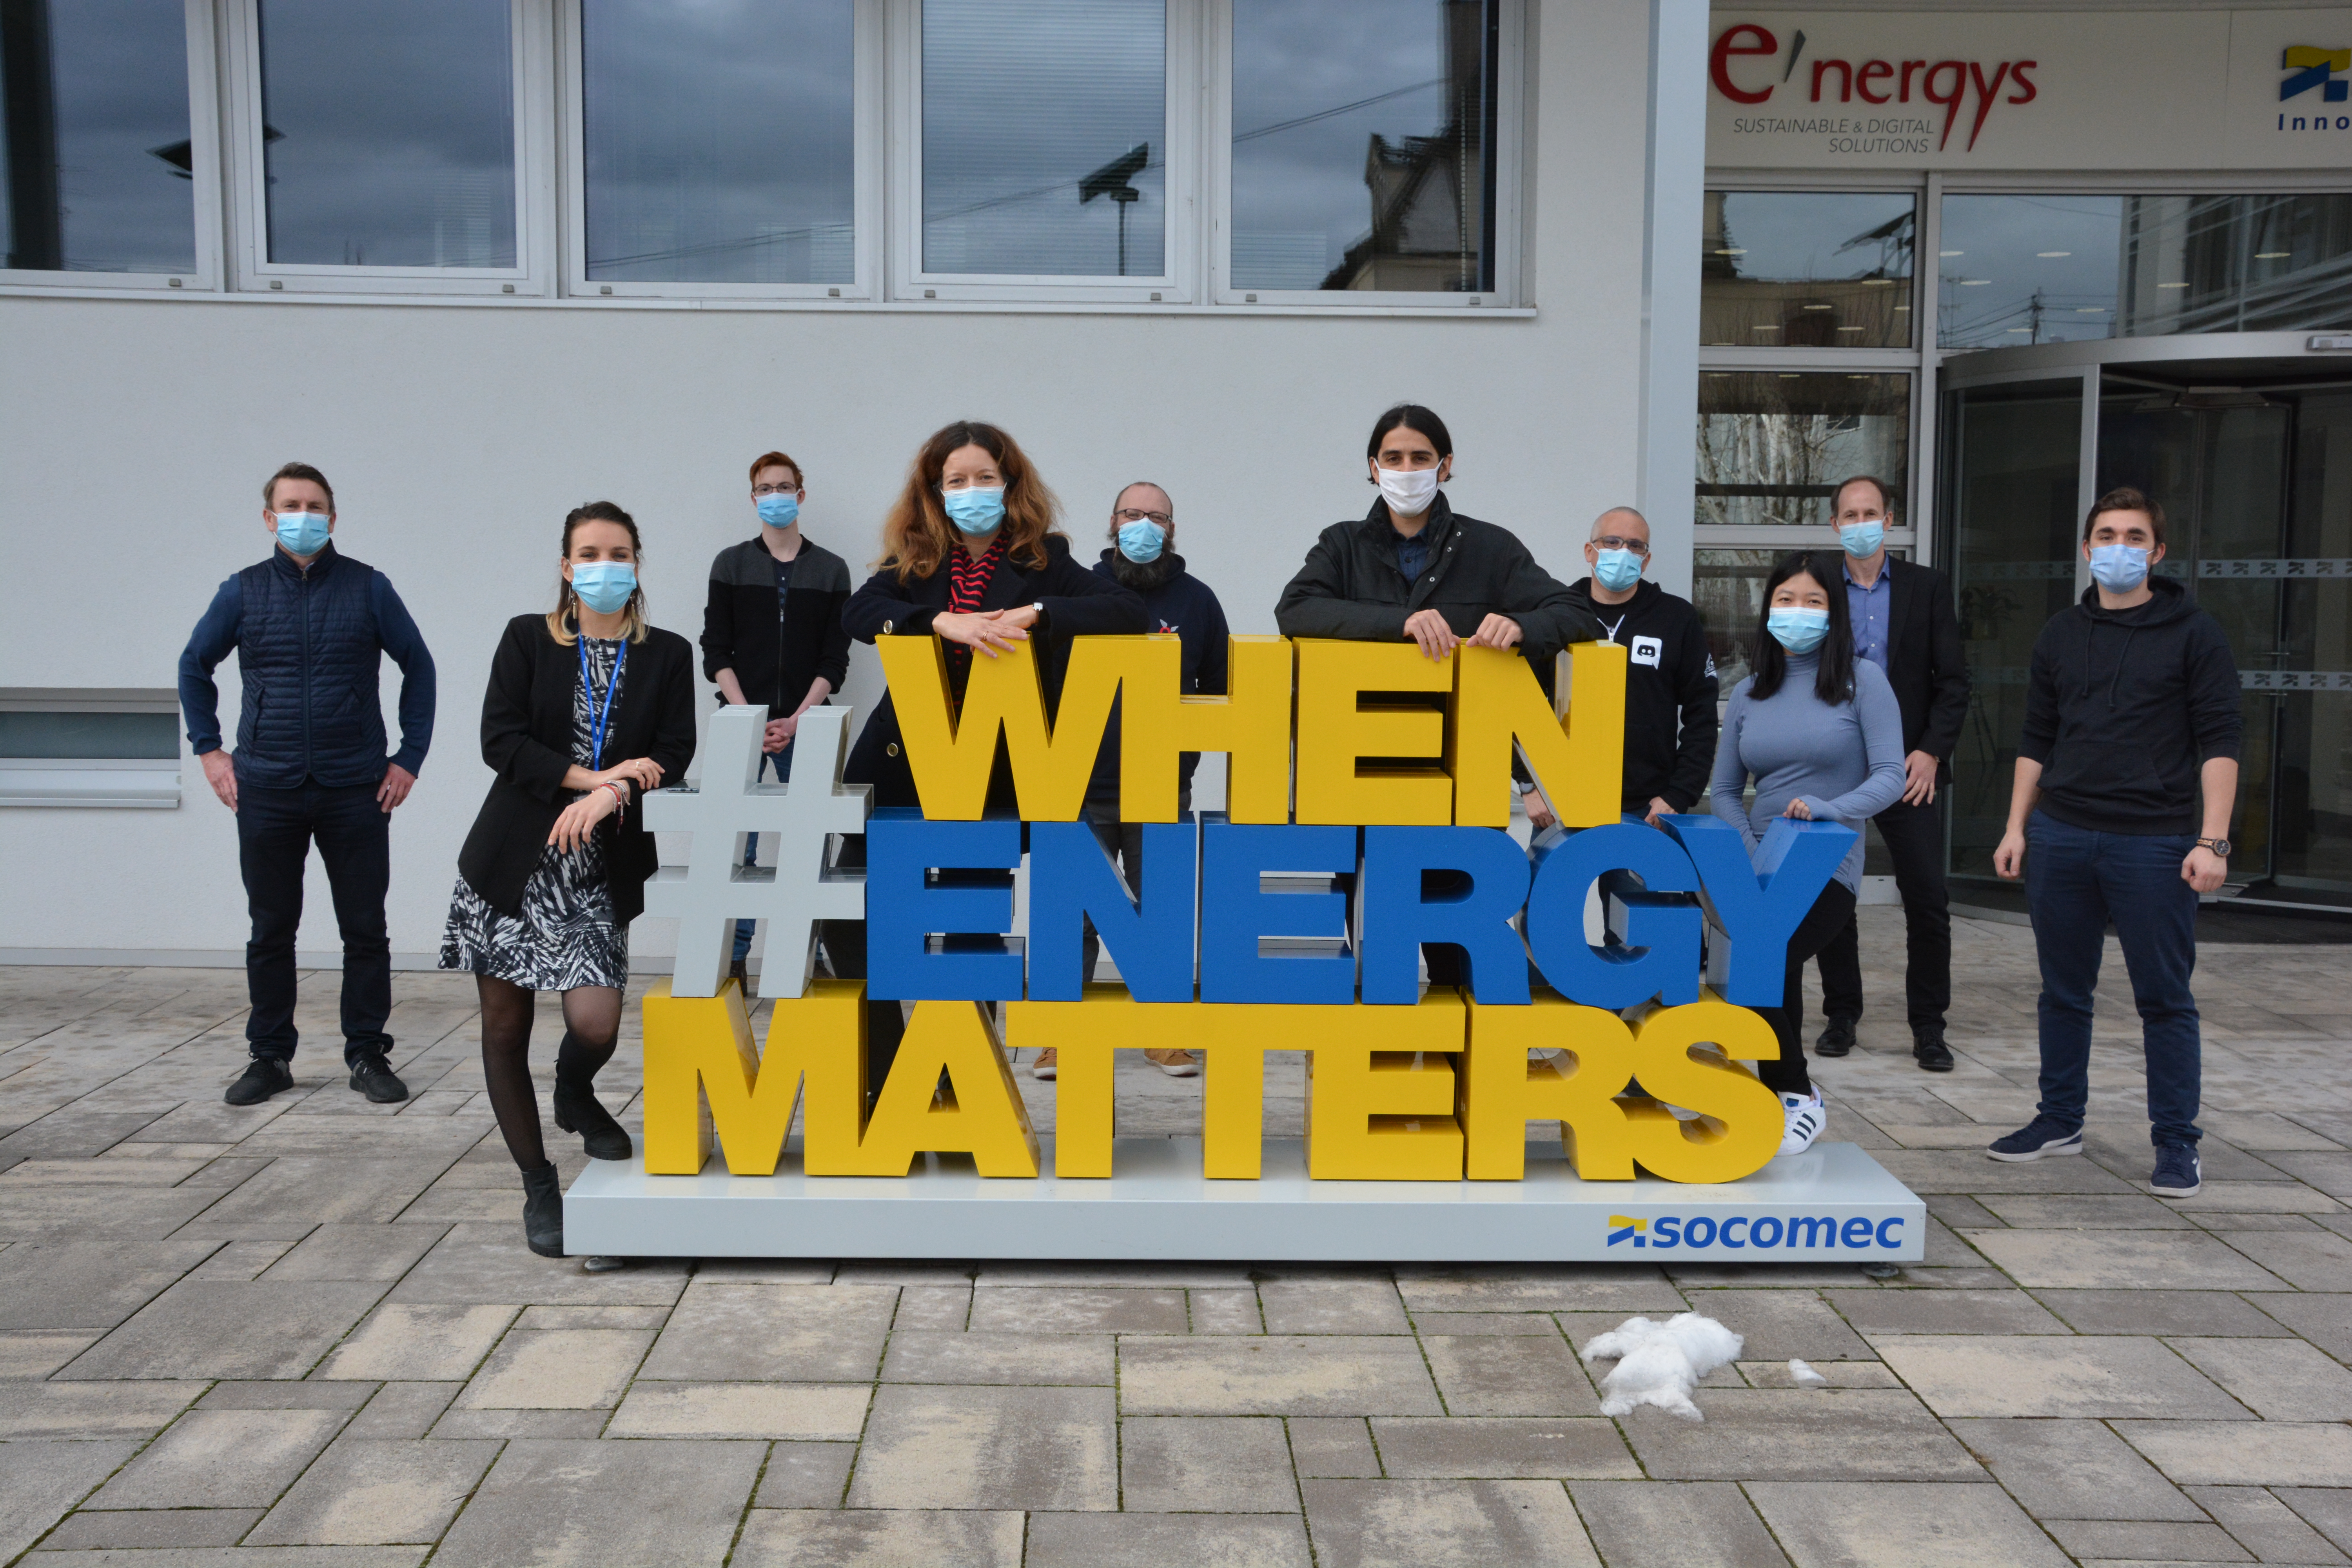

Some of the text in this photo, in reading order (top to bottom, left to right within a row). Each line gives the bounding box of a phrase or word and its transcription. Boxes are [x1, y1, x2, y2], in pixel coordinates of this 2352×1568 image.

[1734, 118, 1934, 134] SUSTAINABLE & DIGITAL
[2278, 113, 2350, 131] Inno
[1829, 138, 1929, 153] SOLUTIONS
[875, 634, 1627, 828] WHEN
[866, 815, 1859, 1009] ENERGY
[642, 986, 1786, 1184] MATTERS
[1652, 1217, 1904, 1249] socomec
